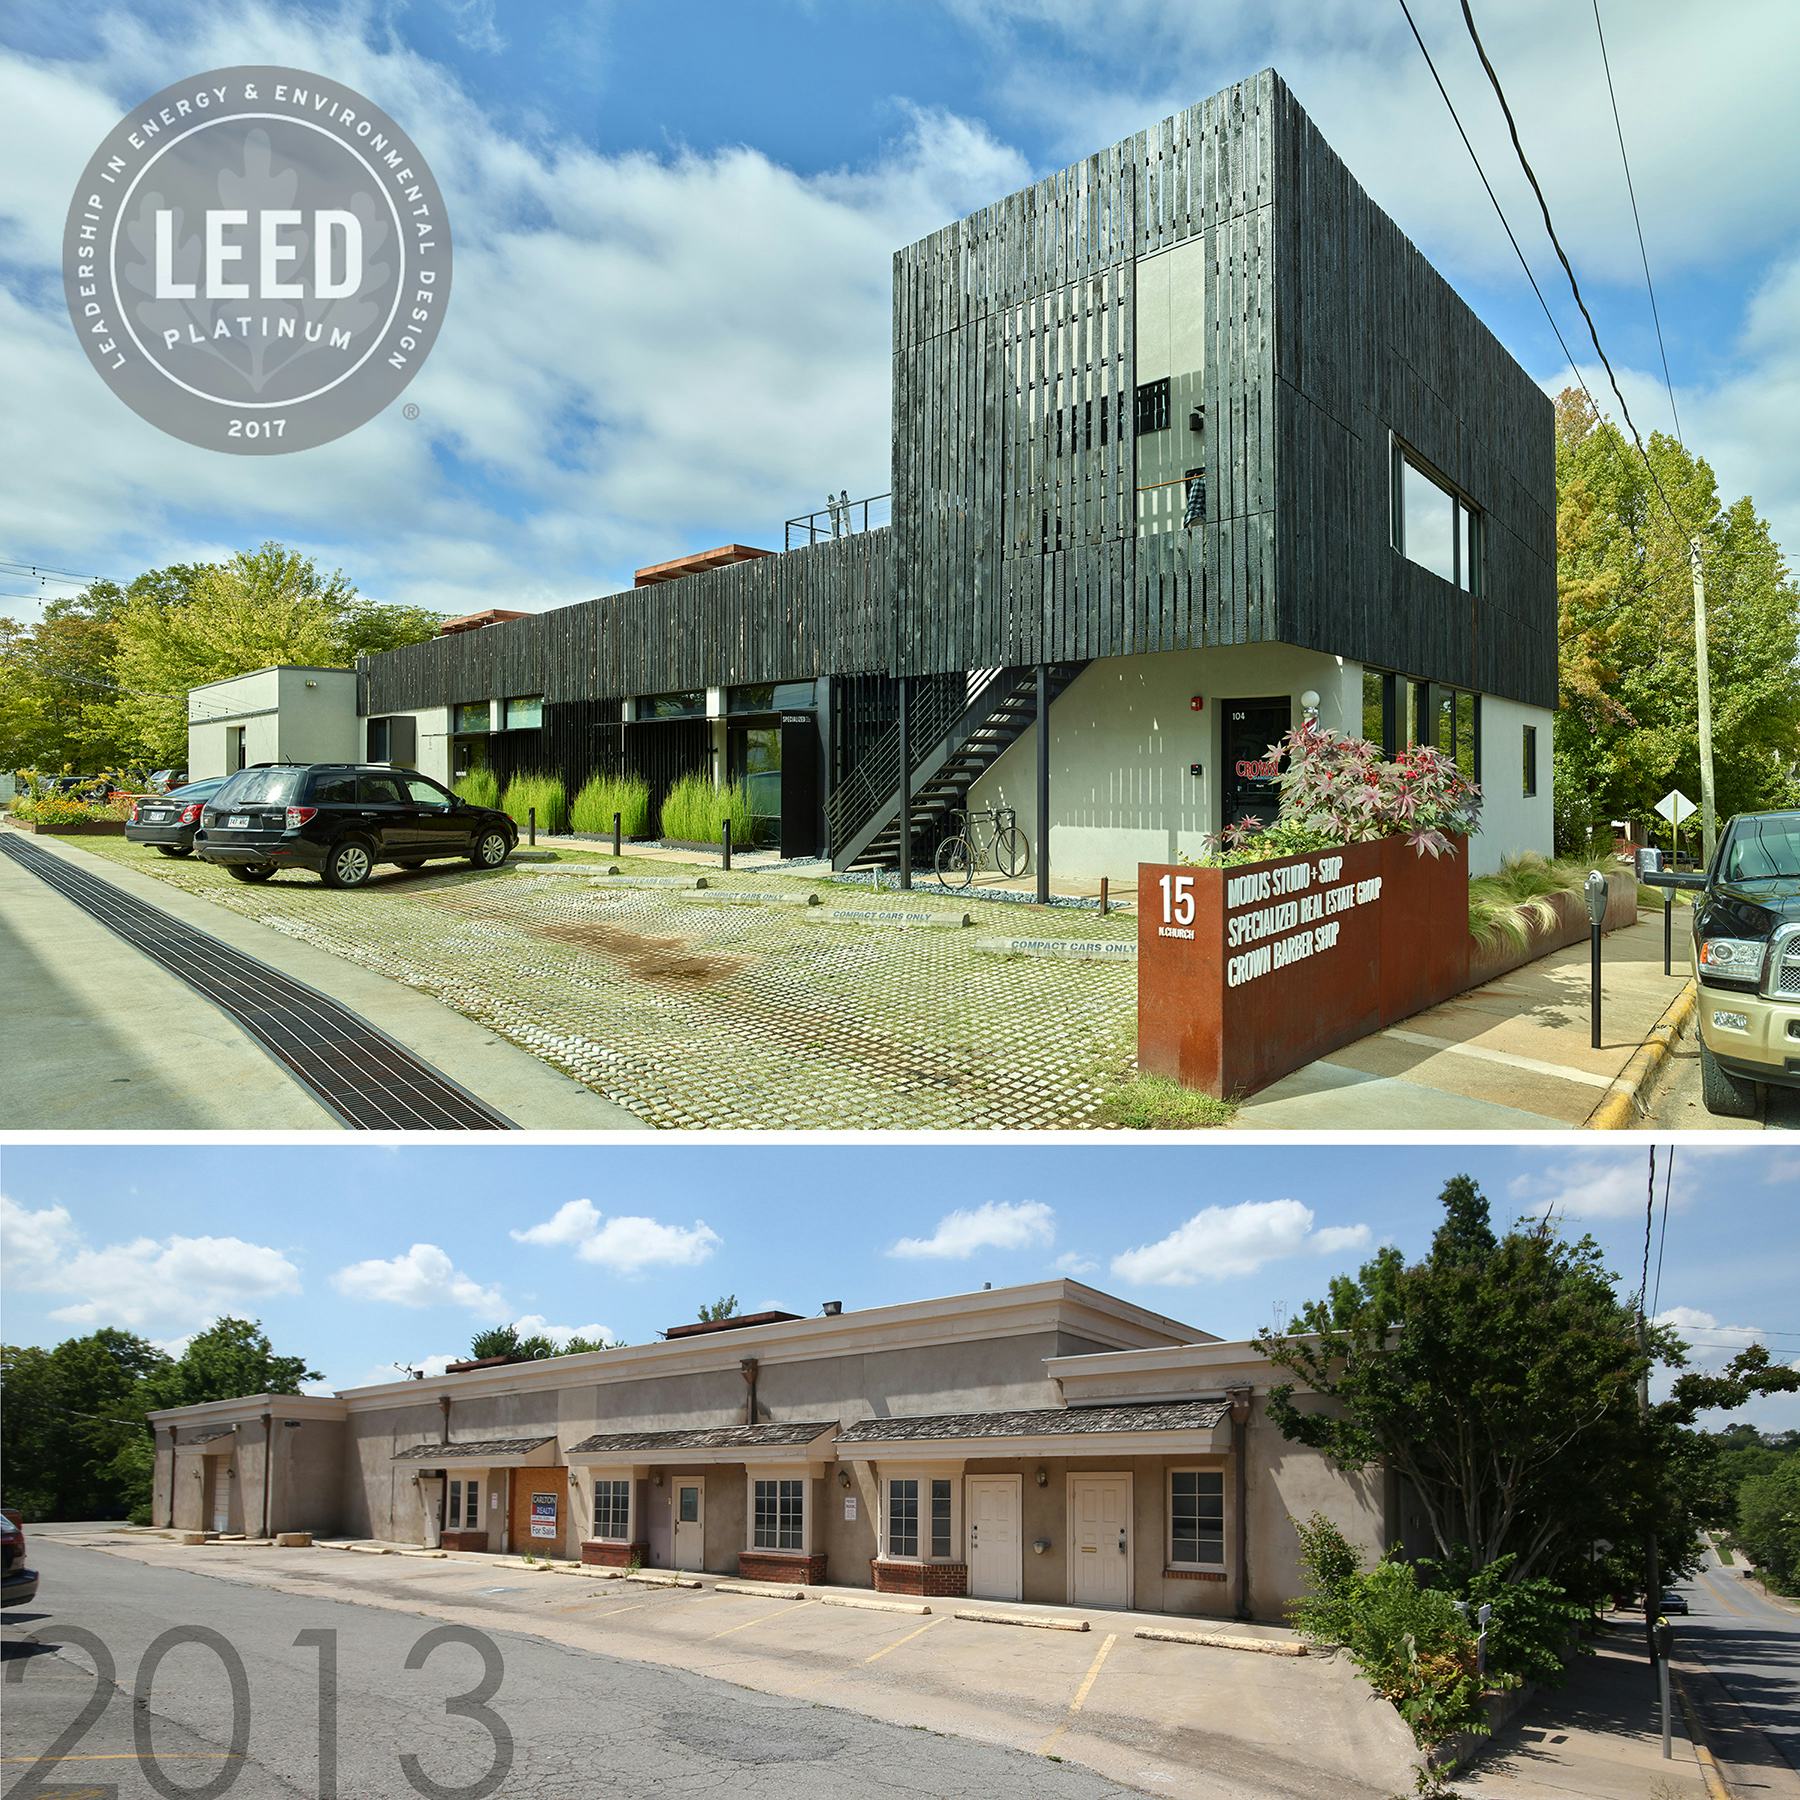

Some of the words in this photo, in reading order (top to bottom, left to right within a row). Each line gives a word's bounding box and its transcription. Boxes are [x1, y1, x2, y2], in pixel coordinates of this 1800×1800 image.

[1232, 712, 1246, 720] 104
[1227, 871, 1271, 909] MODUS
[1272, 862, 1310, 896] STUDIO
[1311, 866, 1318, 880] +
[1318, 856, 1343, 884] SHOP
[703, 891, 739, 899] COMPACT
[740, 892, 761, 900] CARS
[762, 893, 784, 901] ONLY
[1159, 874, 1196, 926] 15
[833, 910, 877, 919] COMPACT
[879, 912, 904, 920] CARS
[905, 913, 931, 921] ONLY
[1228, 901, 1298, 947] SPECIALIZED
[1300, 893, 1324, 924] REAL
[1325, 883, 1356, 915] ESTATE
[1356, 876, 1382, 905] GROUP
[1011, 940, 1067, 951] COMPACT
[1070, 942, 1102, 951] CARS
[1105, 943, 1137, 953] ONLY
[1227, 945, 1271, 988] CROWN
[1273, 930, 1314, 970] BARBER
[1315, 921, 1340, 953] SHOP
[532, 1496, 556, 1504] CARLTON
[536, 1506, 554, 1515] REALTY
[532, 1526, 541, 1534] For
[542, 1527, 555, 1536] Sale
